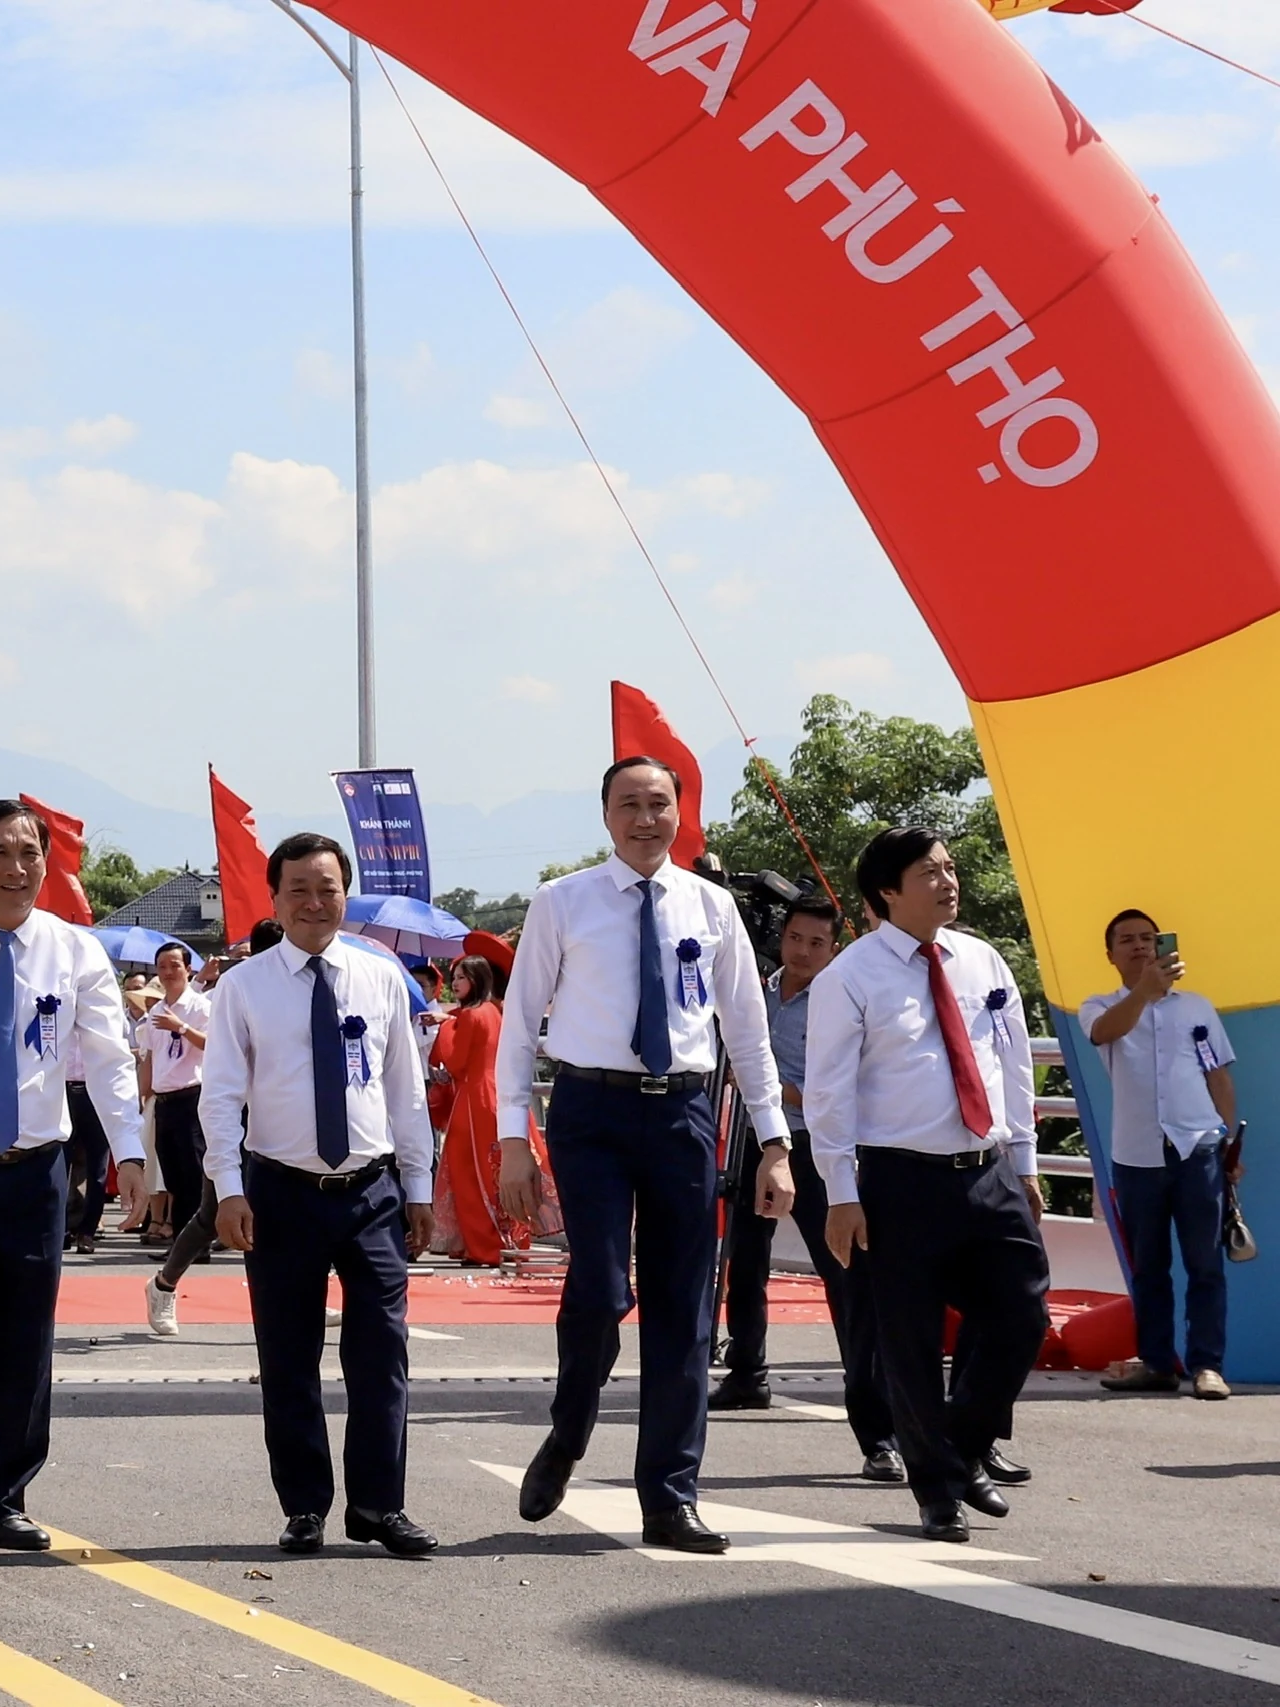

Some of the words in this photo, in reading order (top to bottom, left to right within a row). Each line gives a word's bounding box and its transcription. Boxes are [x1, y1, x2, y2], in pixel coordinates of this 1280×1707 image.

[628, 0, 757, 118] VÀ
[738, 77, 965, 285] PHÚ
[919, 265, 1100, 489] THỌ
[384, 817, 411, 829] THÀNH
